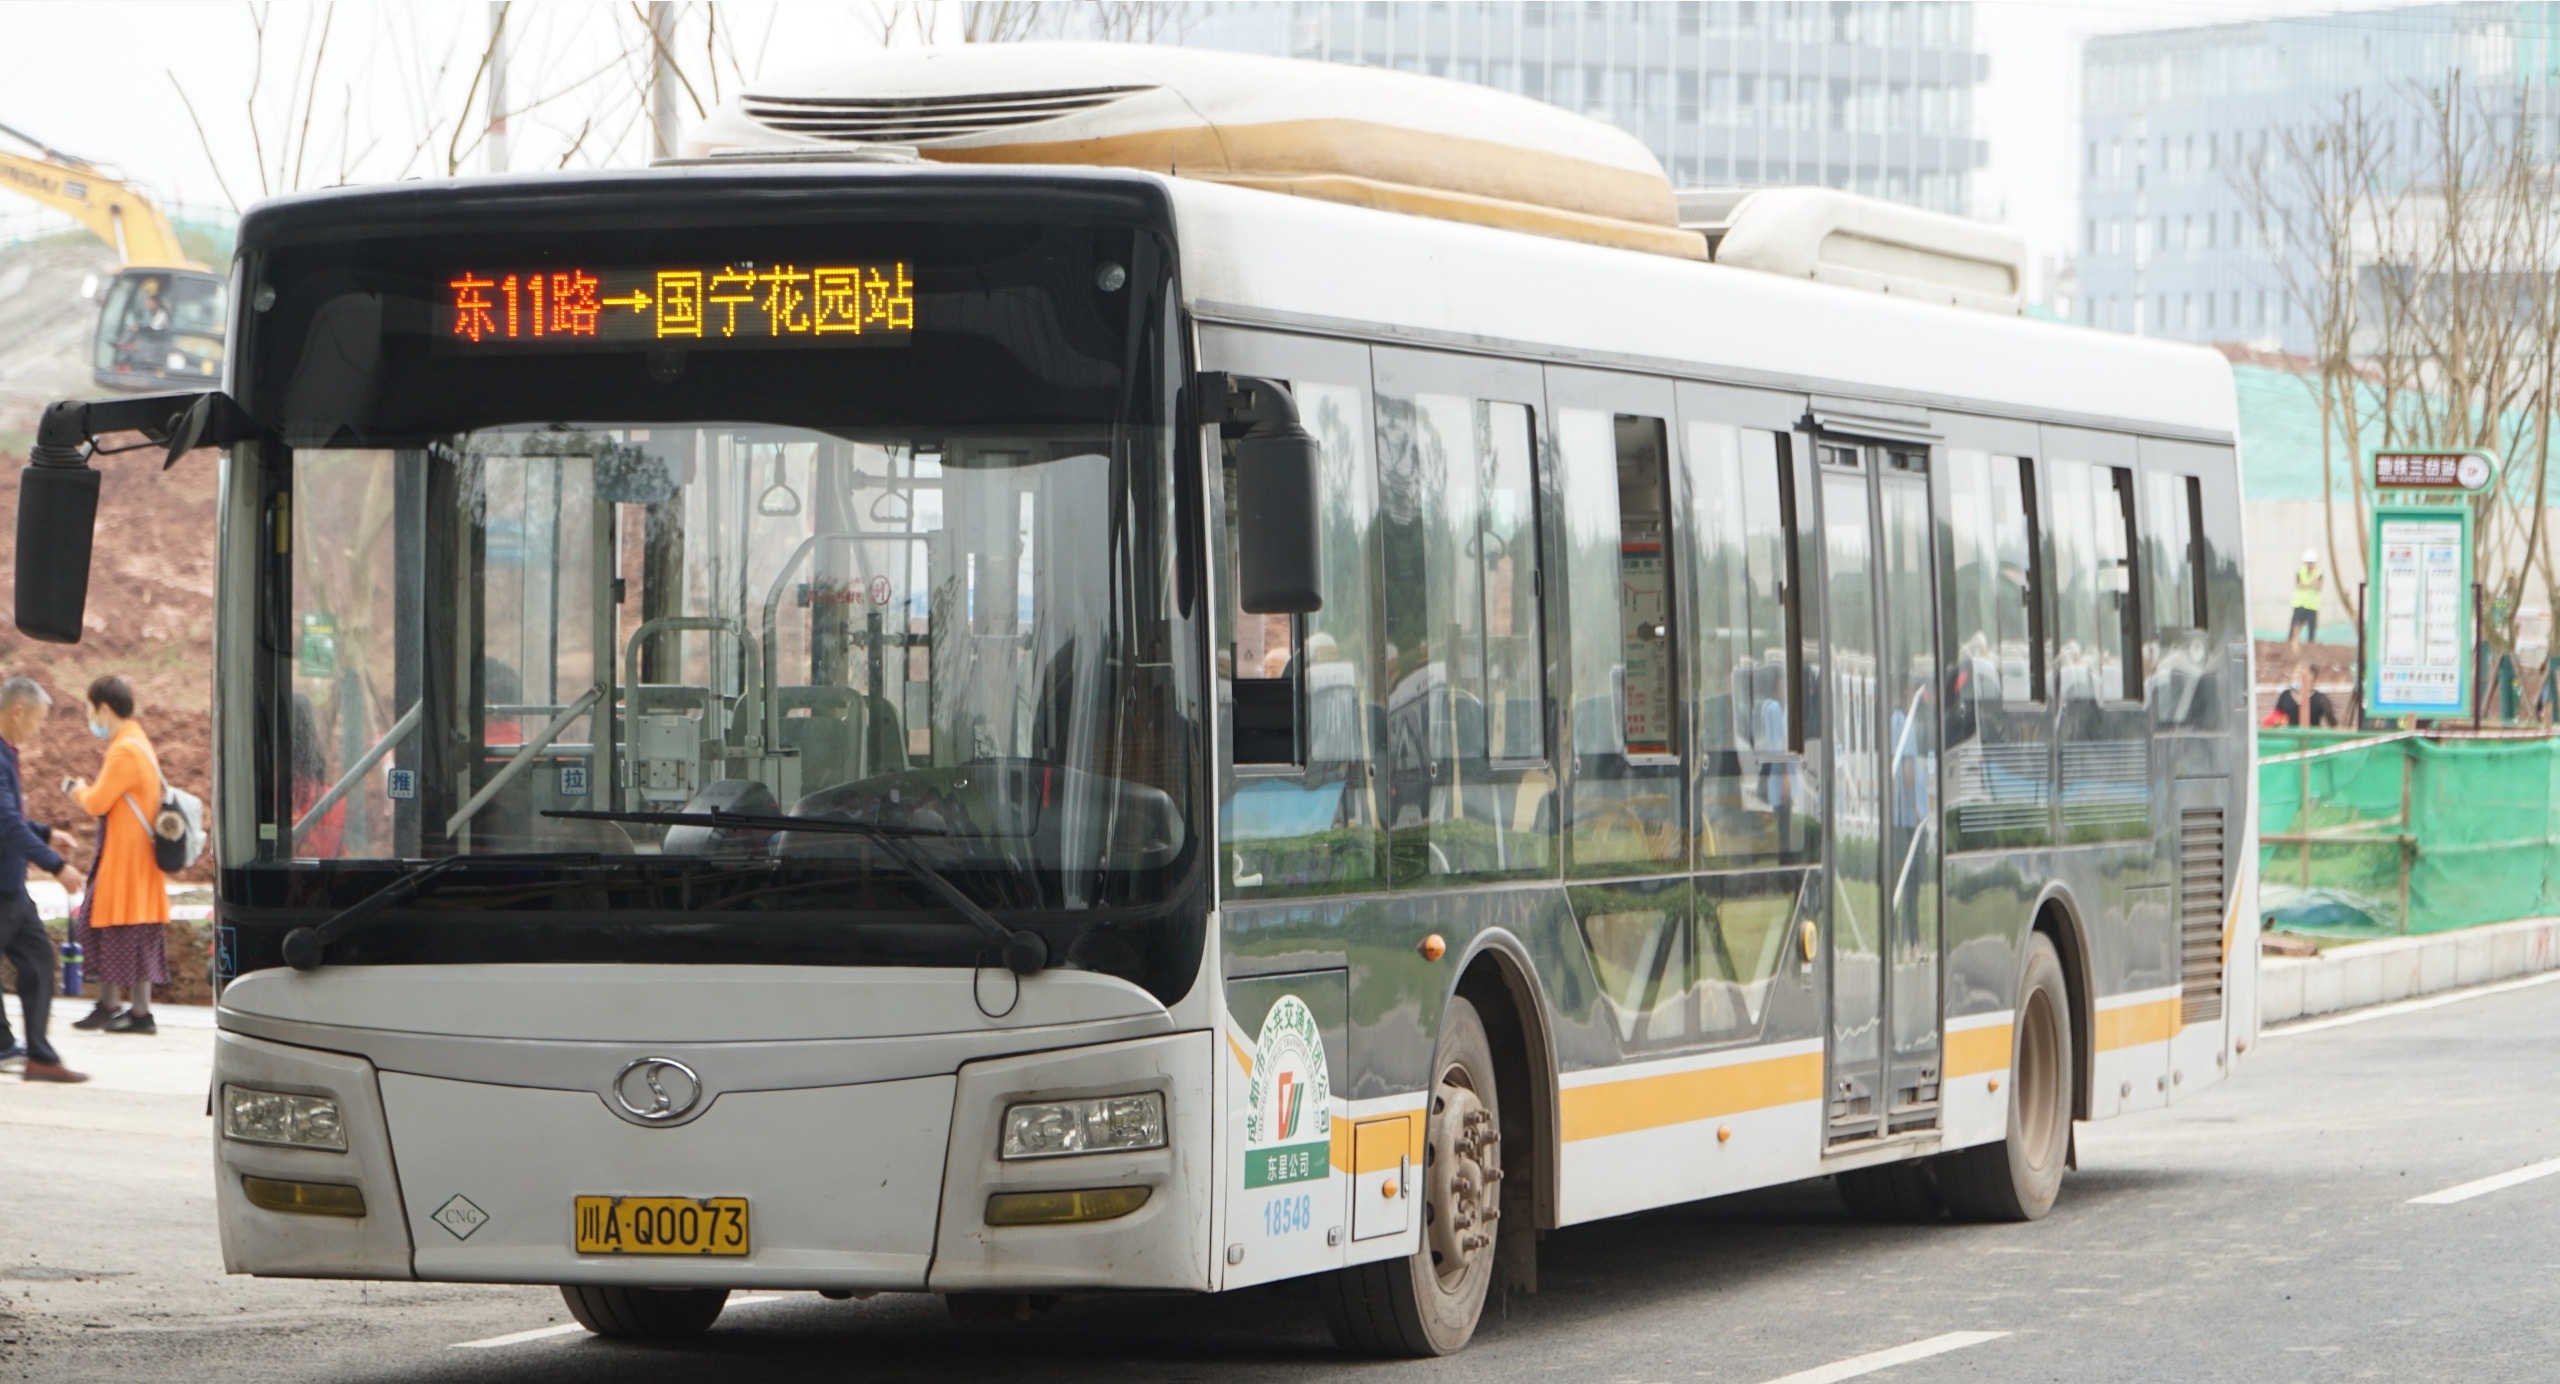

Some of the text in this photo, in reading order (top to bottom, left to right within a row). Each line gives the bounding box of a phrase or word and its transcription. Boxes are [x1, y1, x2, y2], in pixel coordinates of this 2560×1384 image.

[450, 262, 914, 341] 东11路 国宁花园站
[392, 772, 411, 792] 推
[565, 769, 584, 789] 拉
[1267, 1152, 1309, 1181] 东星公司
[445, 1209, 477, 1225] CNG
[1264, 1194, 1310, 1237] 18548
